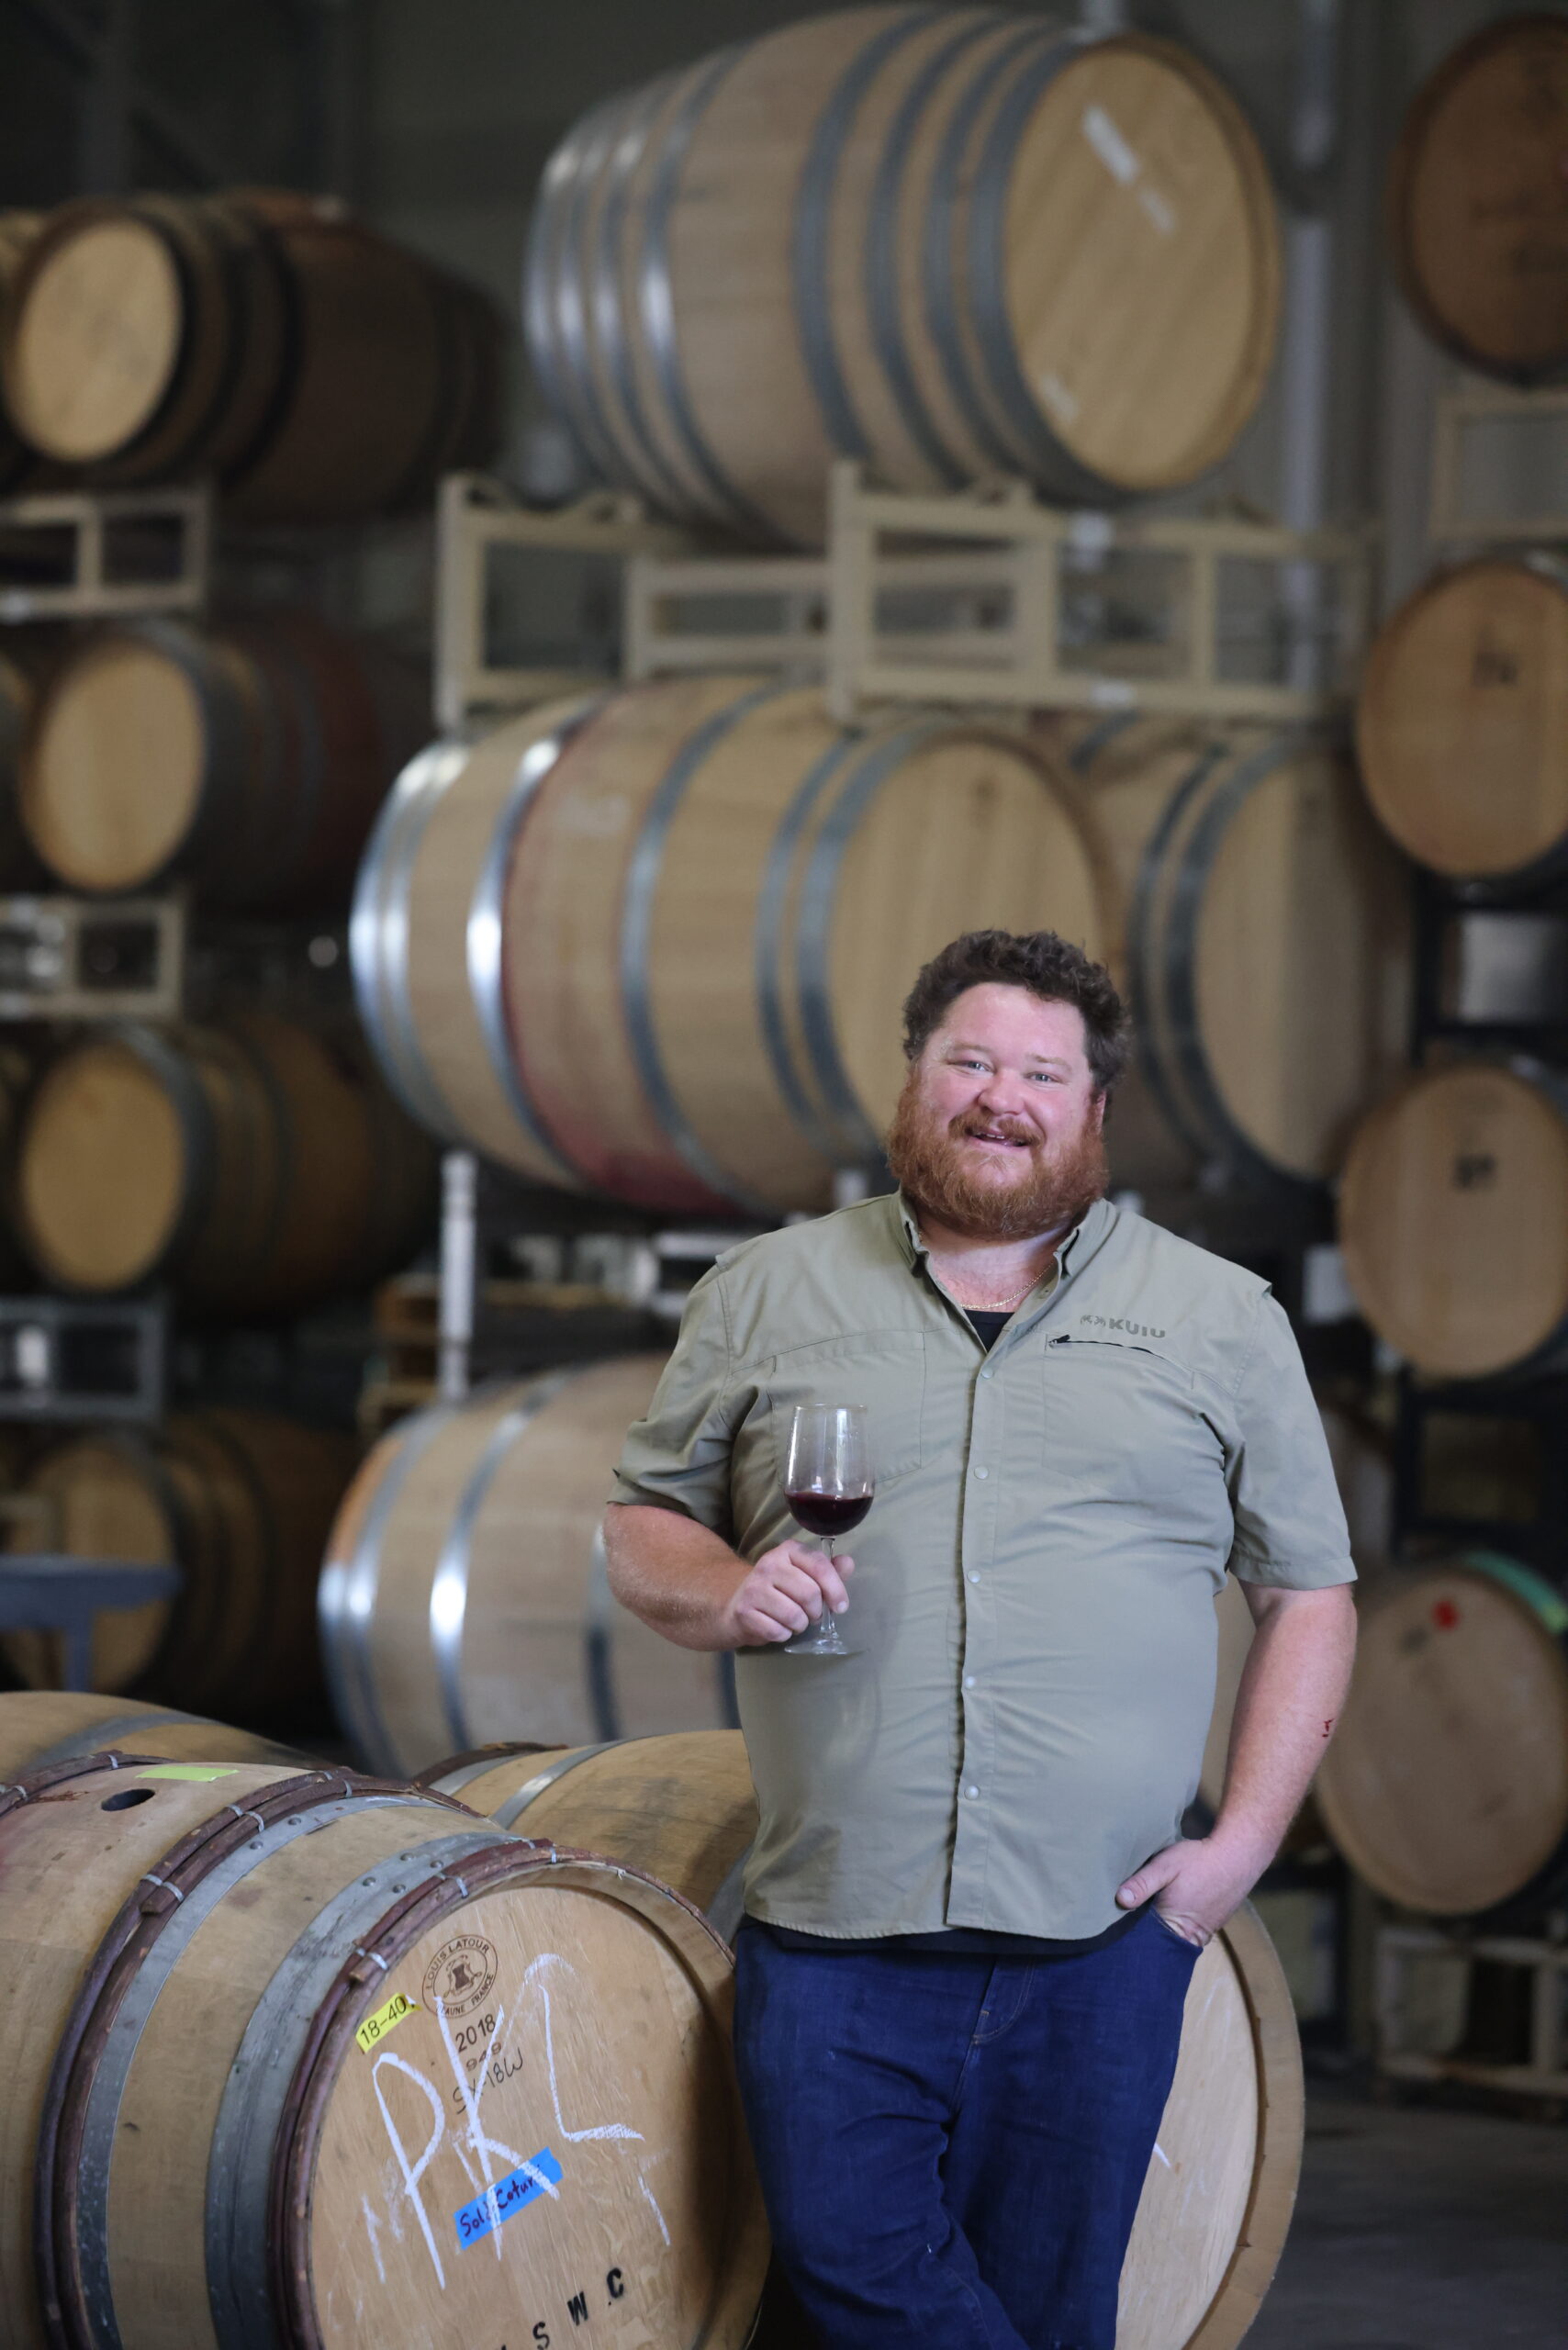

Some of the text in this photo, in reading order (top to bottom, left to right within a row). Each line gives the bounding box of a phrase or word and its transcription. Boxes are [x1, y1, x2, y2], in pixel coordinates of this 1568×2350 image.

[1108, 1317, 1166, 1338] KUIU
[425, 1938, 489, 1989] LOUIS LATOUR
[470, 1973, 495, 2006] FRANCE
[360, 1996, 415, 2045] 18-40
[455, 2013, 496, 2053] 2018
